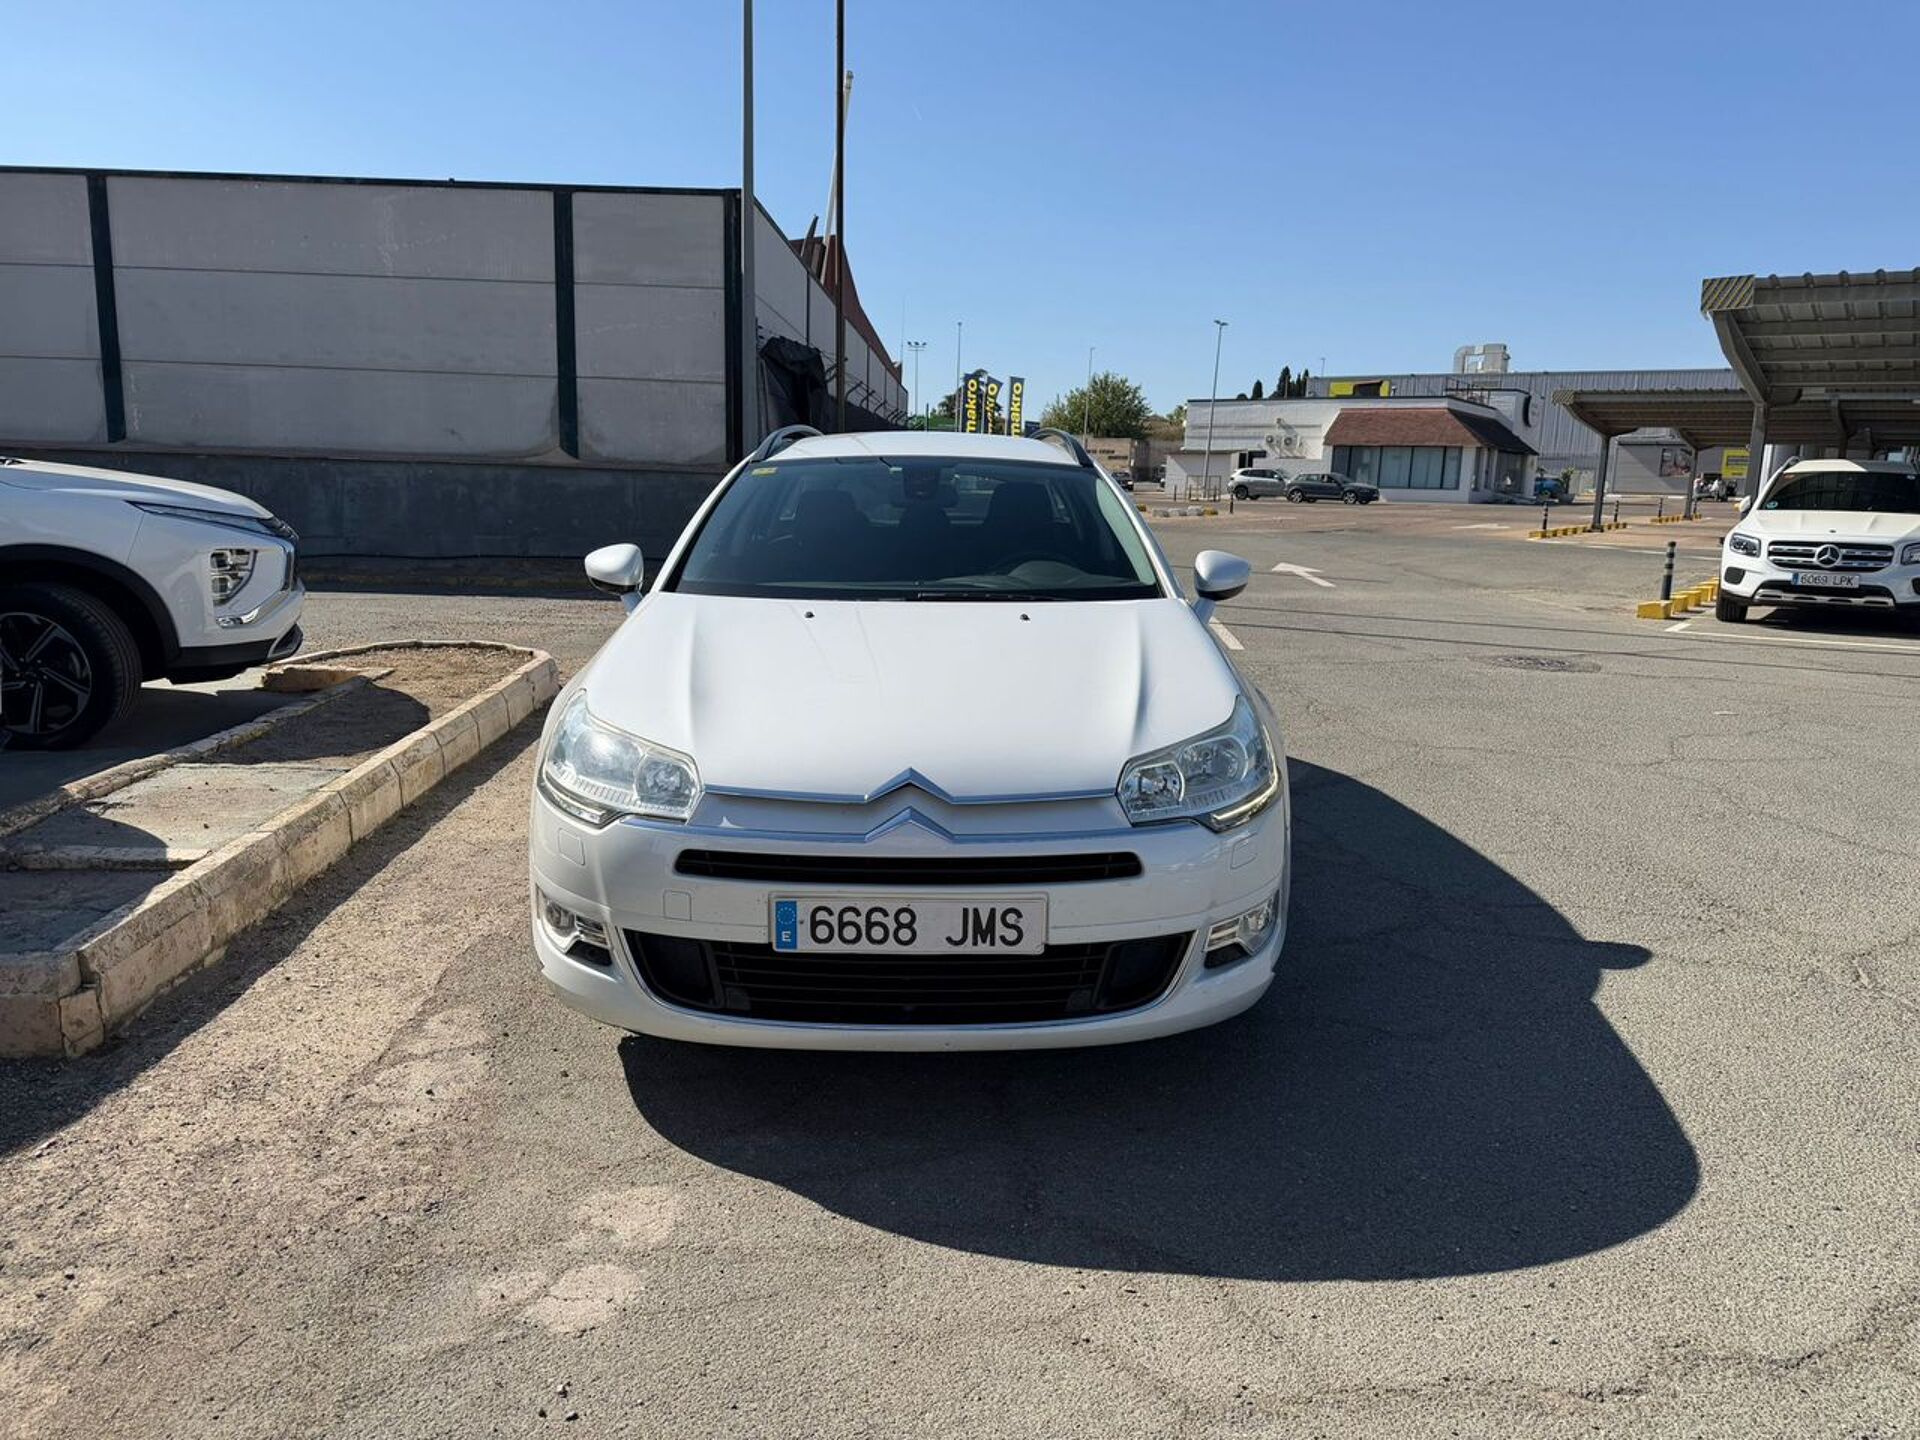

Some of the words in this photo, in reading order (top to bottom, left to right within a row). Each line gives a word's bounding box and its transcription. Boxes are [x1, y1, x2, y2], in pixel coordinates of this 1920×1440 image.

[1011, 382, 1023, 438] makro
[1833, 575, 1853, 586] LPK
[782, 930, 791, 942] E
[809, 905, 917, 946] 6668
[945, 907, 1024, 947] JMS
